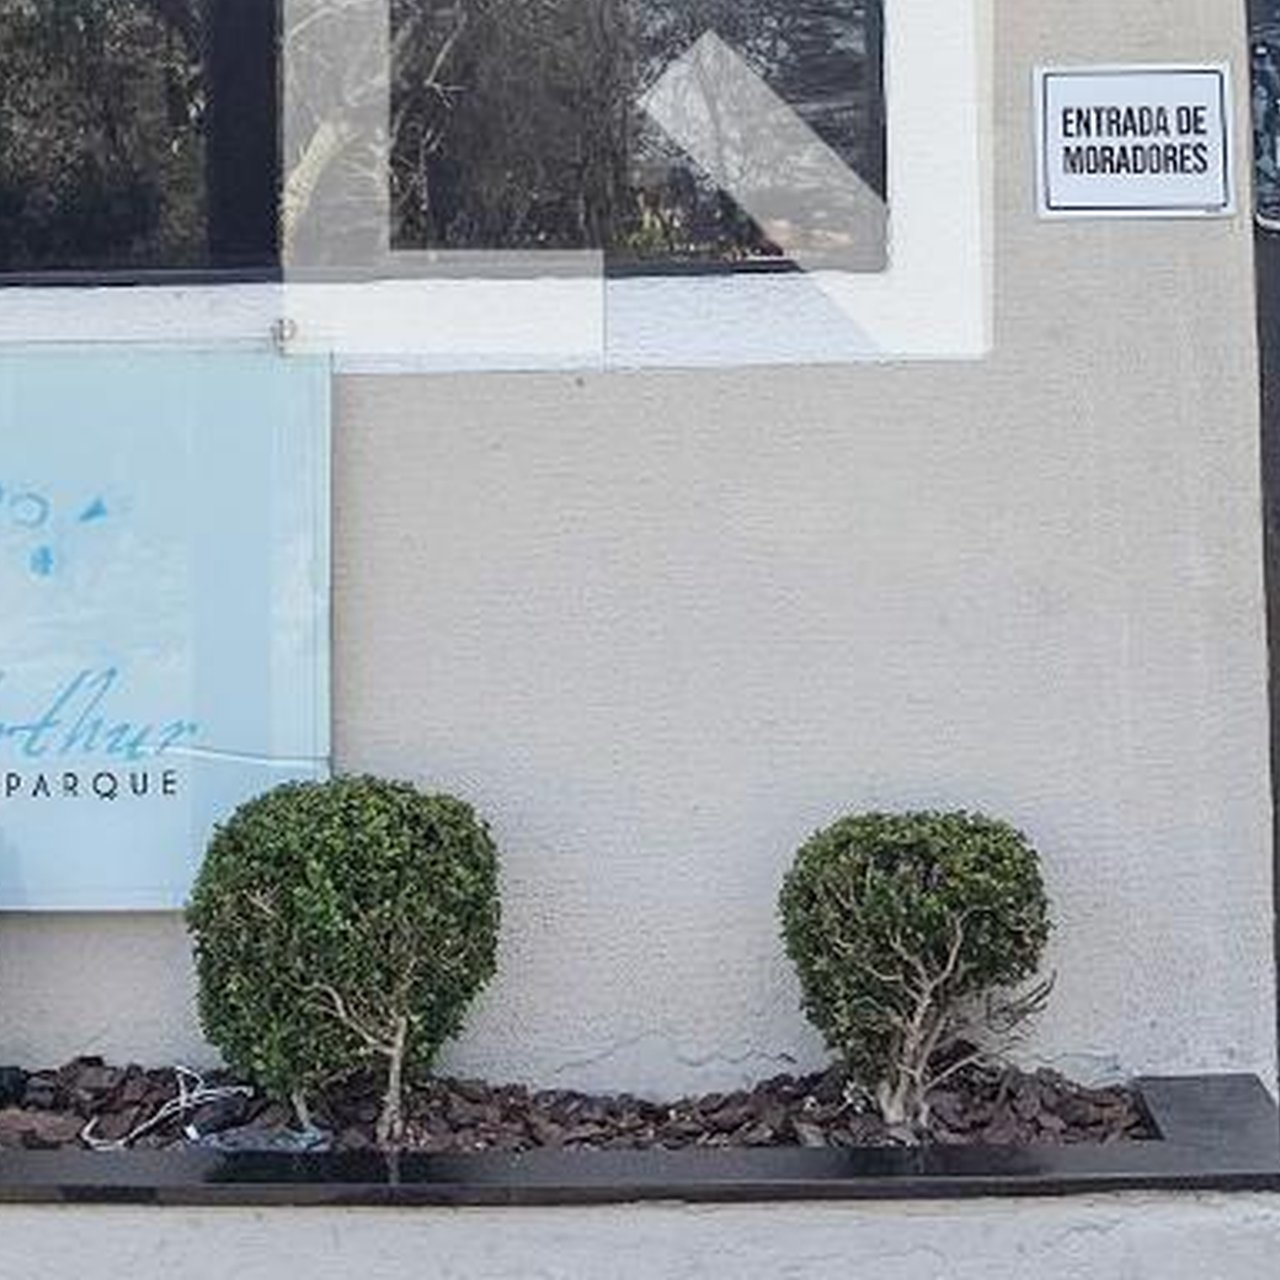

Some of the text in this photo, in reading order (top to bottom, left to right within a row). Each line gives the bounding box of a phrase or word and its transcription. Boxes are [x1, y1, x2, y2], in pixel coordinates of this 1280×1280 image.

[1062, 105, 1208, 138] ENTRADA DE
[1062, 142, 1208, 175] MORADORES
[5, 769, 178, 801] PARQUE
